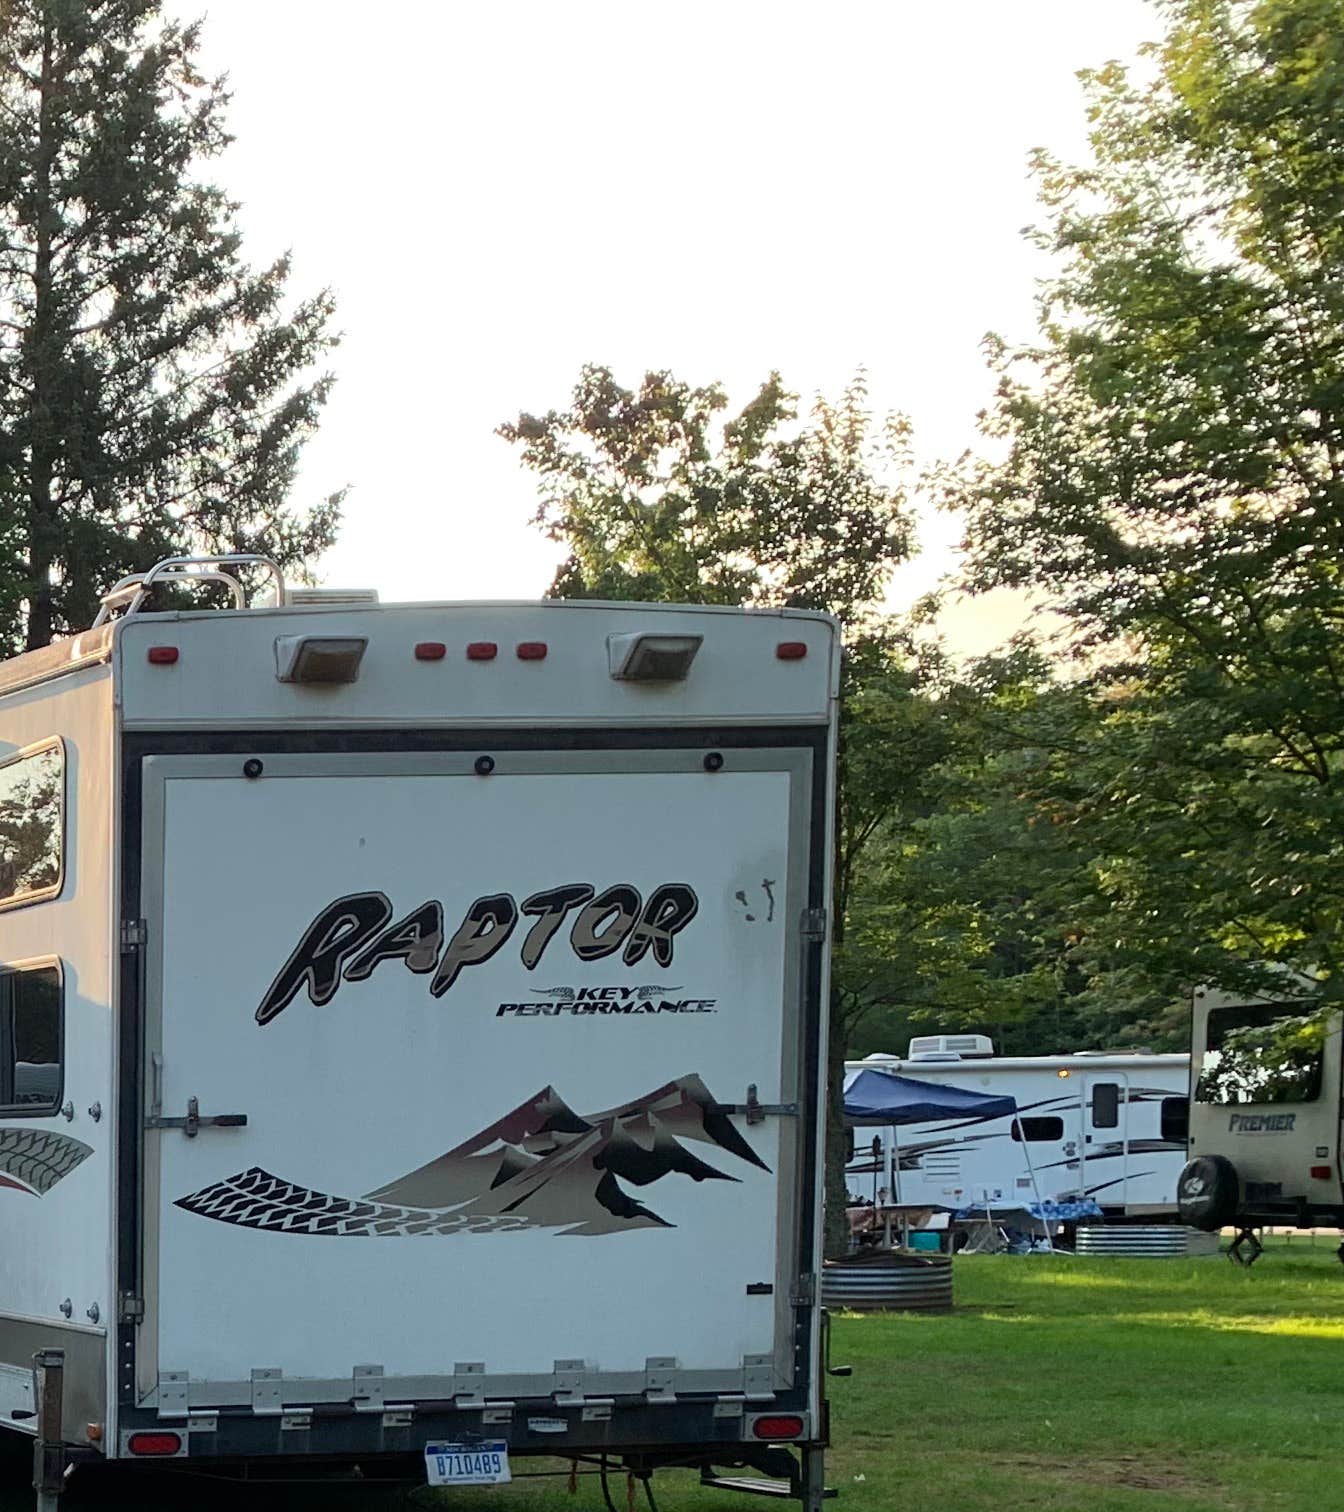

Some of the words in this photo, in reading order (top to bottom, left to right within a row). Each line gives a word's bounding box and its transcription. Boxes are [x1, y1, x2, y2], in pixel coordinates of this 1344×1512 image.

[255, 884, 699, 1026] RAPTOR
[576, 986, 640, 1001] KEY
[496, 999, 717, 1017] PERFORMANCE
[1229, 1113, 1296, 1132] PREMIER
